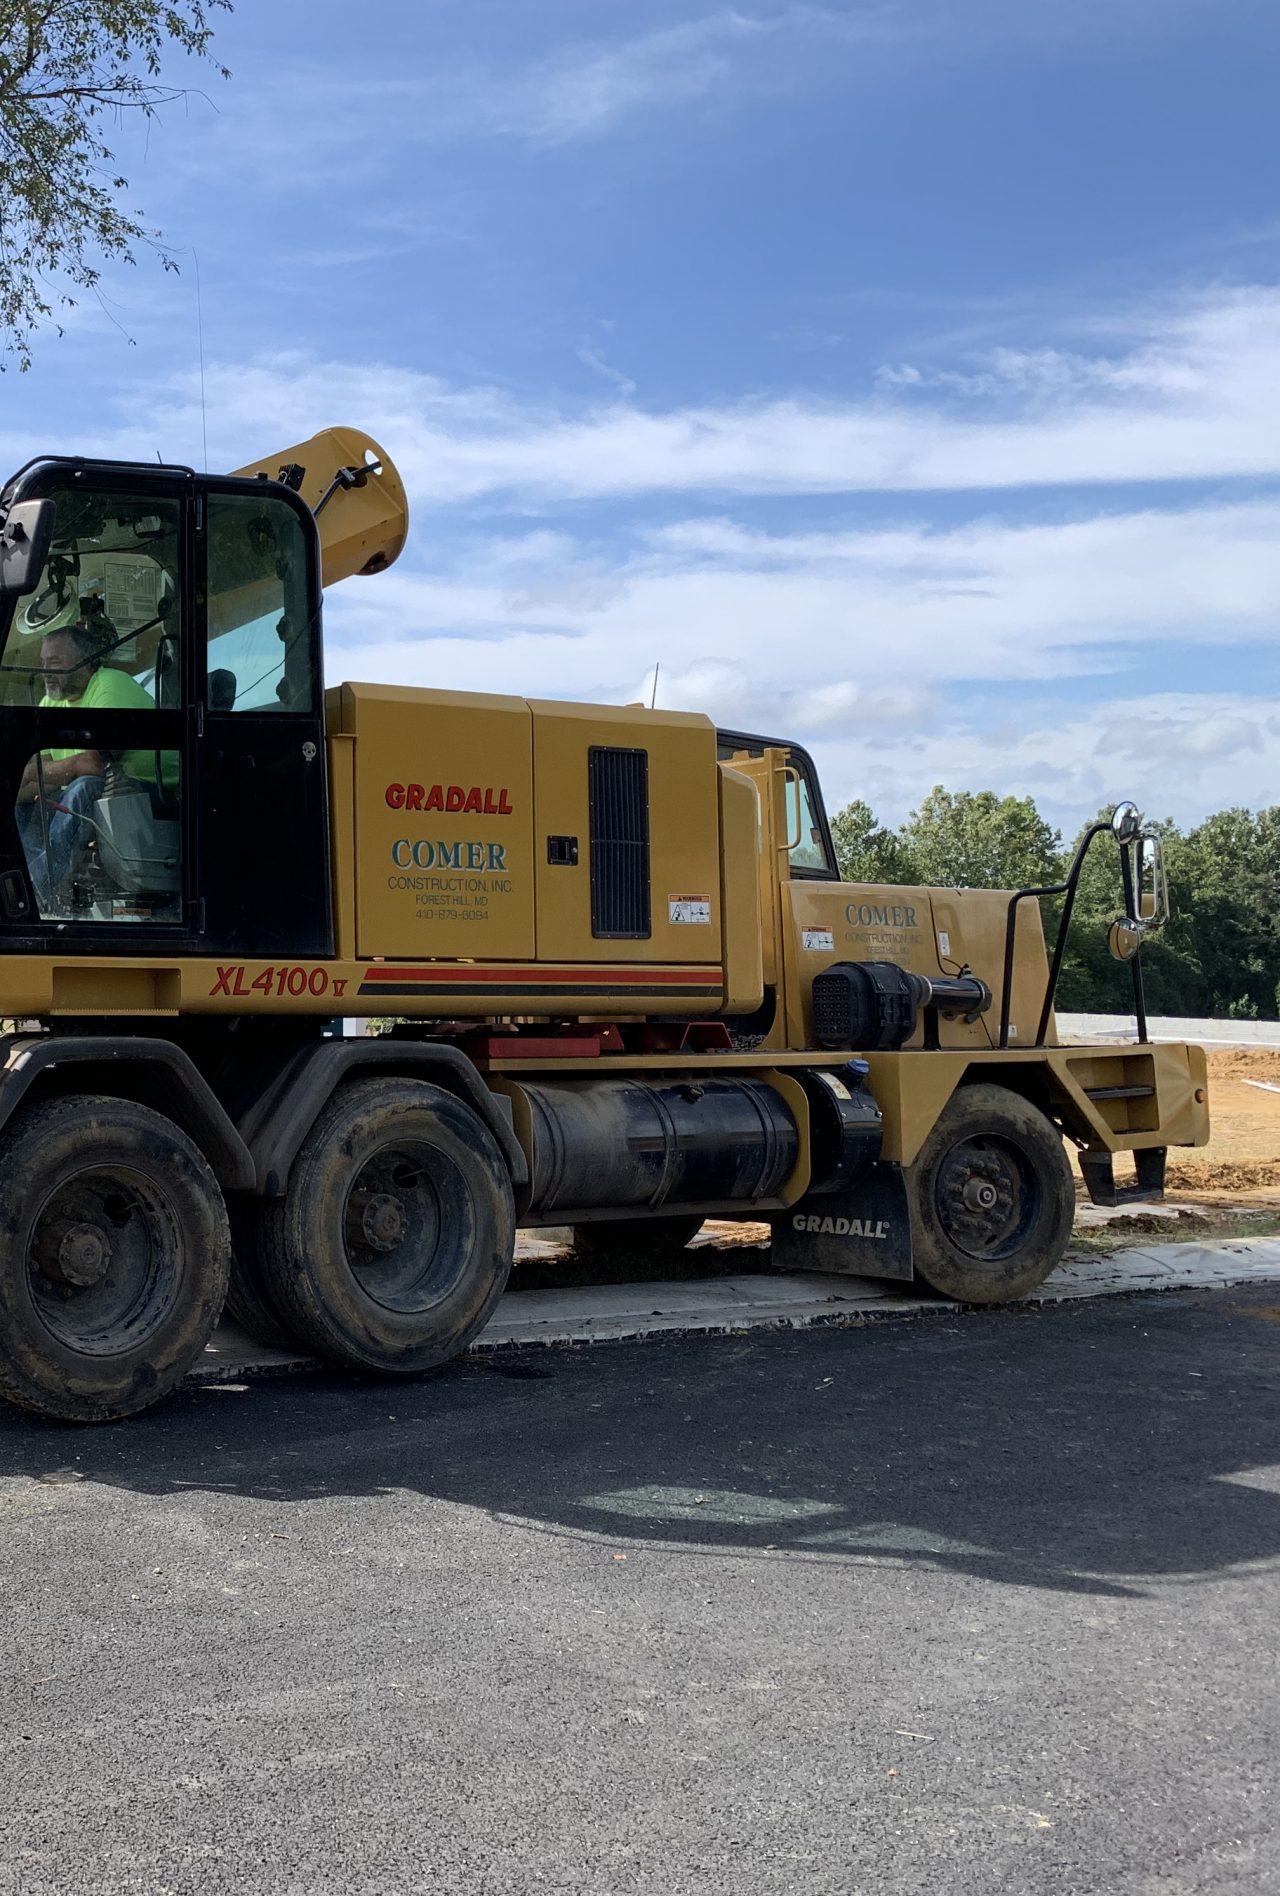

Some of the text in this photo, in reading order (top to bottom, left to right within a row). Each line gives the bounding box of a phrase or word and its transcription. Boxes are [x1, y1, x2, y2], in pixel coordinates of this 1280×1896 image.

[385, 783, 513, 815] GRADALL
[392, 839, 509, 873] COMER
[415, 894, 450, 906] FOREST
[845, 904, 918, 929] COMER
[208, 966, 329, 996] XL4100
